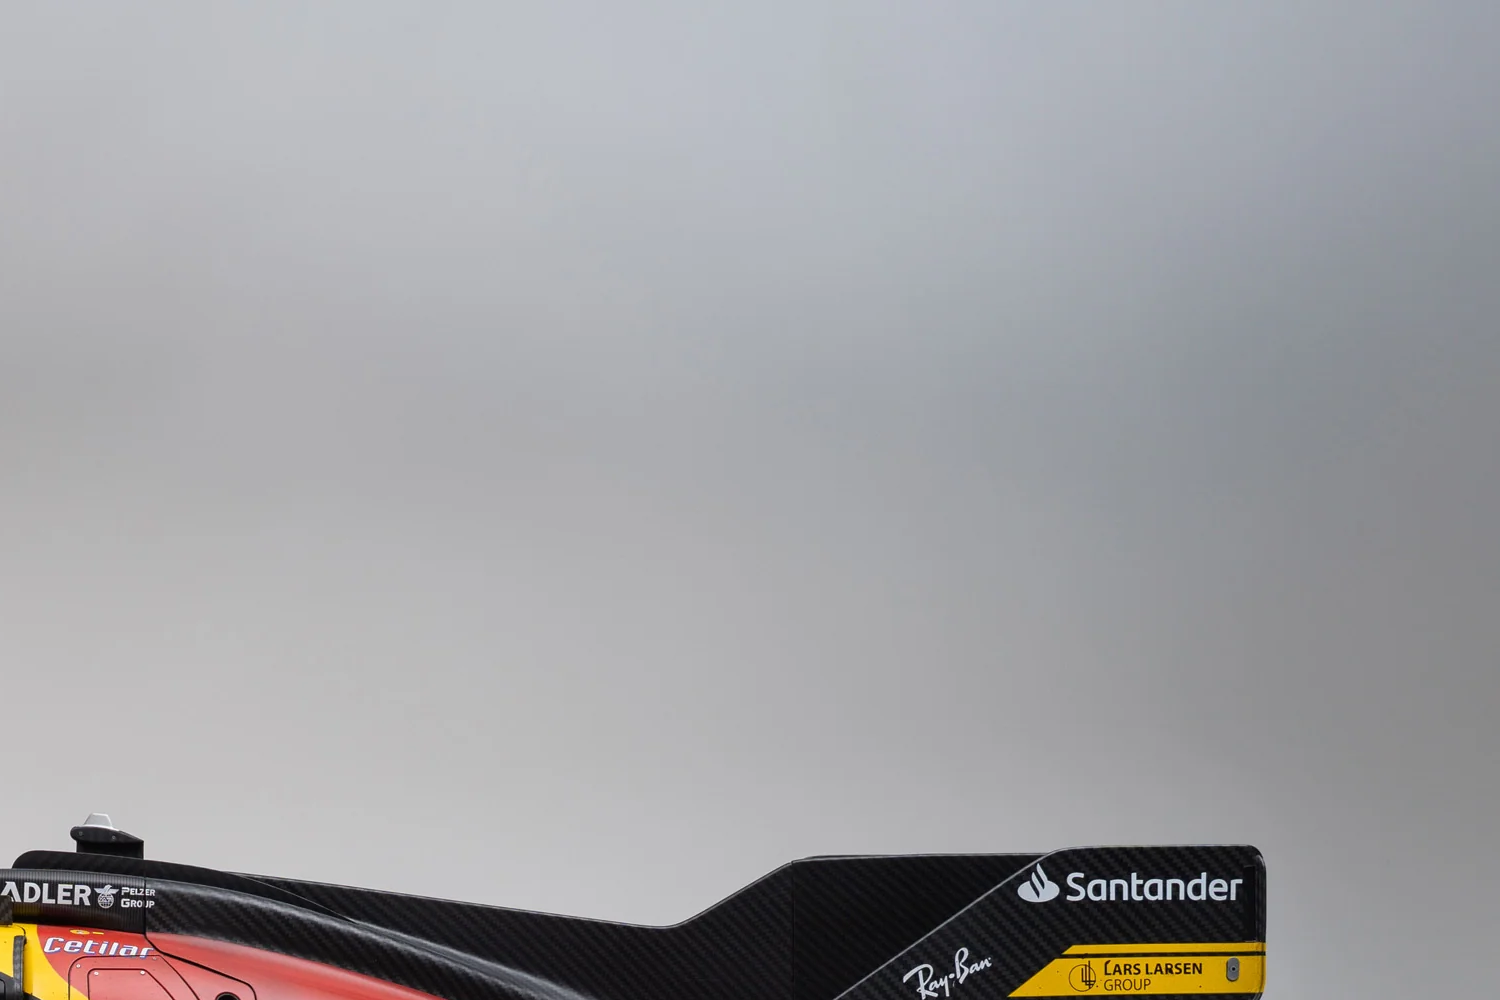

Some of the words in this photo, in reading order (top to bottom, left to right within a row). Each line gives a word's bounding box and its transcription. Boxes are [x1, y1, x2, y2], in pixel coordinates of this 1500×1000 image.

[1, 881, 92, 906] ADLER
[1066, 872, 1243, 901] Santander
[43, 936, 155, 959] Cetilar
[1103, 959, 1141, 976] LARS
[1145, 962, 1203, 975] LARSEN
[1103, 978, 1152, 992] GROUP
